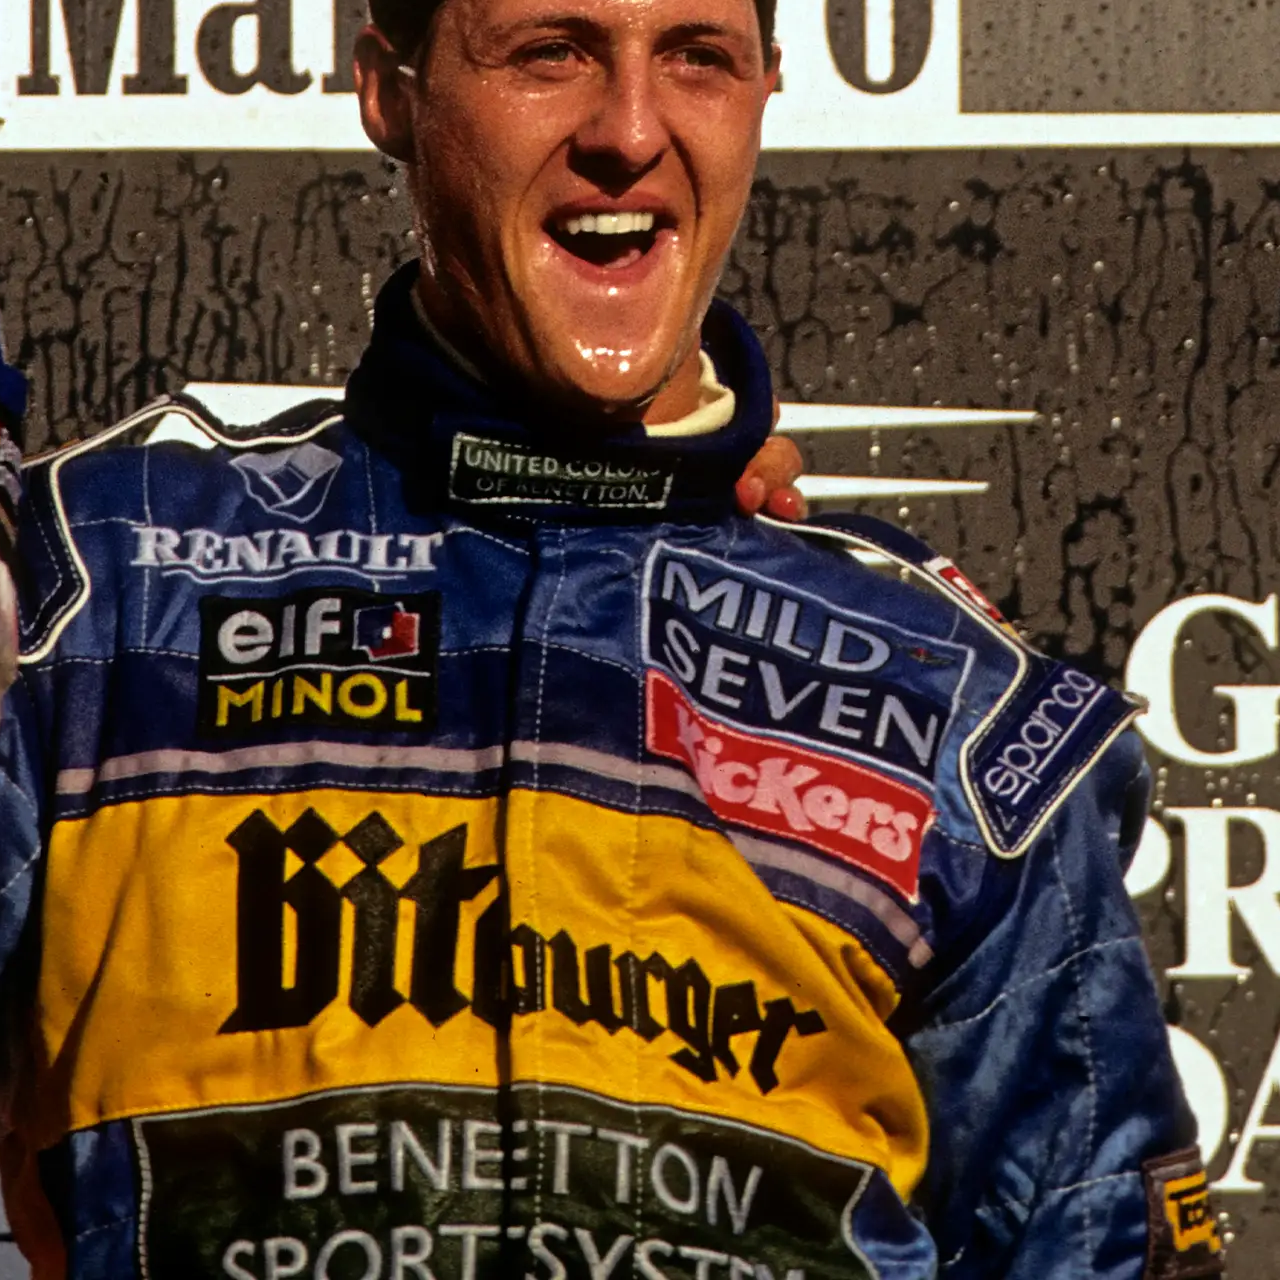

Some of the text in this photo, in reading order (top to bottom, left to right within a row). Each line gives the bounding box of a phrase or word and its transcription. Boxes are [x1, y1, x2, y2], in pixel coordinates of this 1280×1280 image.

[463, 445, 558, 474] UNITED
[476, 476, 510, 493] OF
[130, 527, 444, 572] RENAULT
[218, 597, 342, 665] elf
[660, 560, 891, 673] MILD
[216, 672, 423, 727] MINOL
[662, 618, 939, 768] SEVEN
[984, 669, 1097, 797] sparco
[282, 1120, 763, 1235] BENETTON
